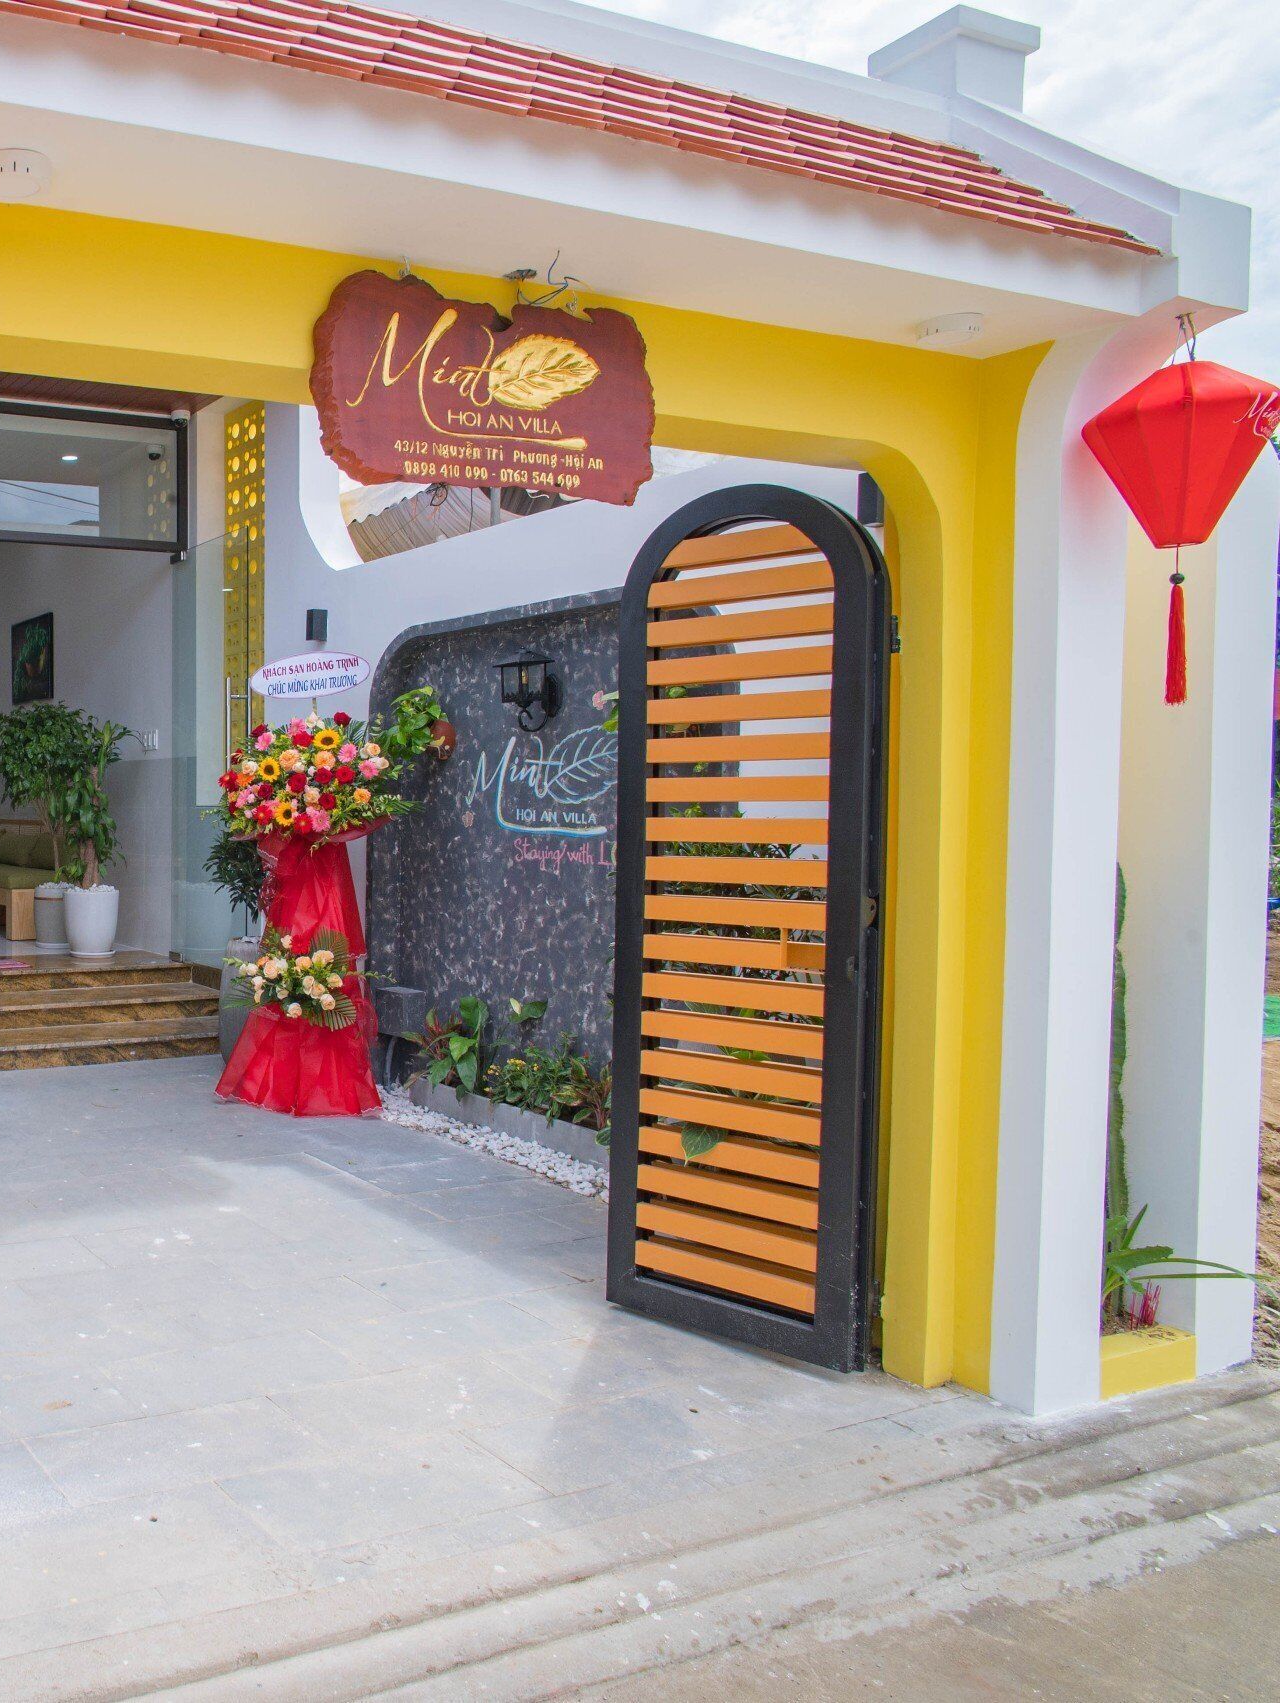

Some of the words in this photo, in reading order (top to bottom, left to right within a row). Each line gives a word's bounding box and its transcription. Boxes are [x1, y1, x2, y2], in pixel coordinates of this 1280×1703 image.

[486, 412, 514, 431] AN
[518, 415, 563, 436] VILLA
[394, 439, 428, 455] 43/12
[588, 456, 604, 470] An
[404, 460, 436, 476] 0898
[439, 463, 460, 478] 410
[465, 466, 488, 480] 090
[500, 468, 528, 483] 0763
[532, 471, 554, 485] 544
[309, 677, 328, 691] KHAI
[540, 809, 558, 825] AN
[562, 811, 598, 825] VILLA
[513, 837, 567, 876] Staying
[567, 841, 595, 865] with
